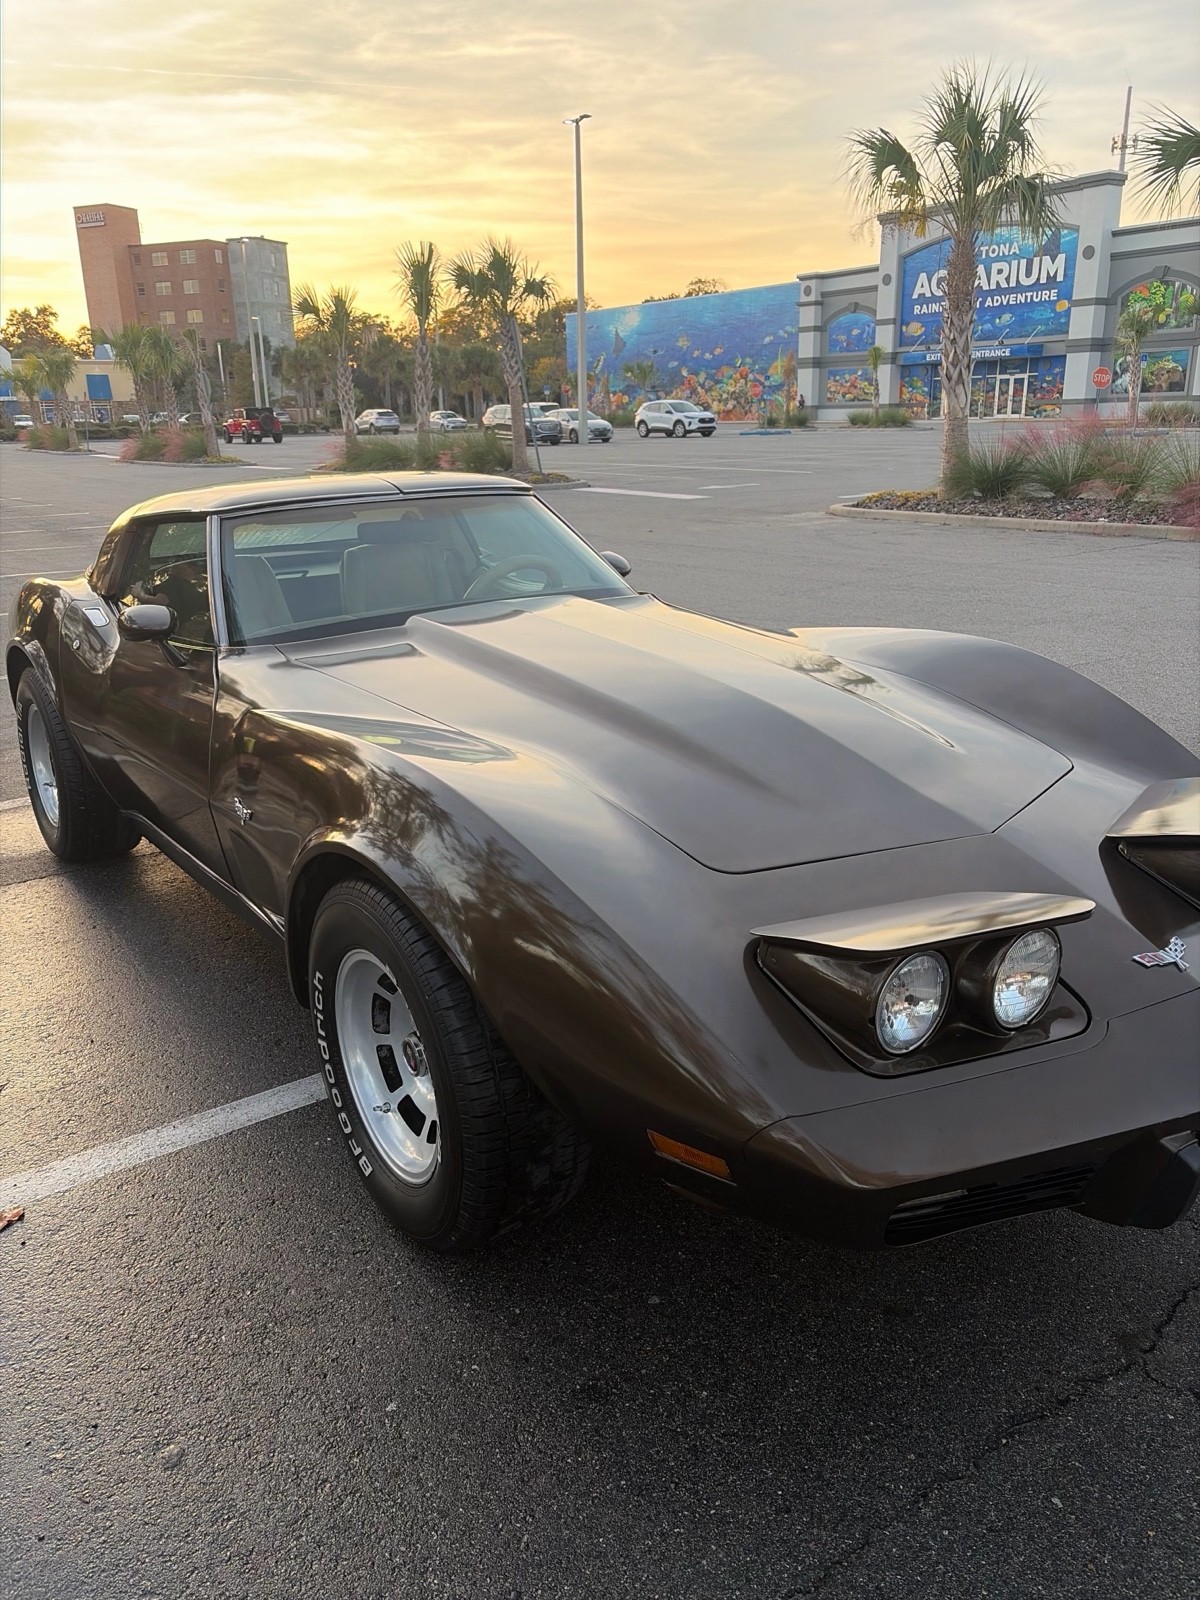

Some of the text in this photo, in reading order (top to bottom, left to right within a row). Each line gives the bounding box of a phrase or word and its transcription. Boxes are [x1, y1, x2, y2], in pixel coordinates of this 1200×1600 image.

[974, 241, 1020, 259] TONA
[912, 253, 1066, 298] AQARIUM
[913, 289, 1058, 315] RAINFT ADVENTURE
[926, 348, 1011, 361] EXIT ENTRANCE
[1093, 373, 1111, 383] STOP
[313, 970, 374, 1178] BFGoodrich
